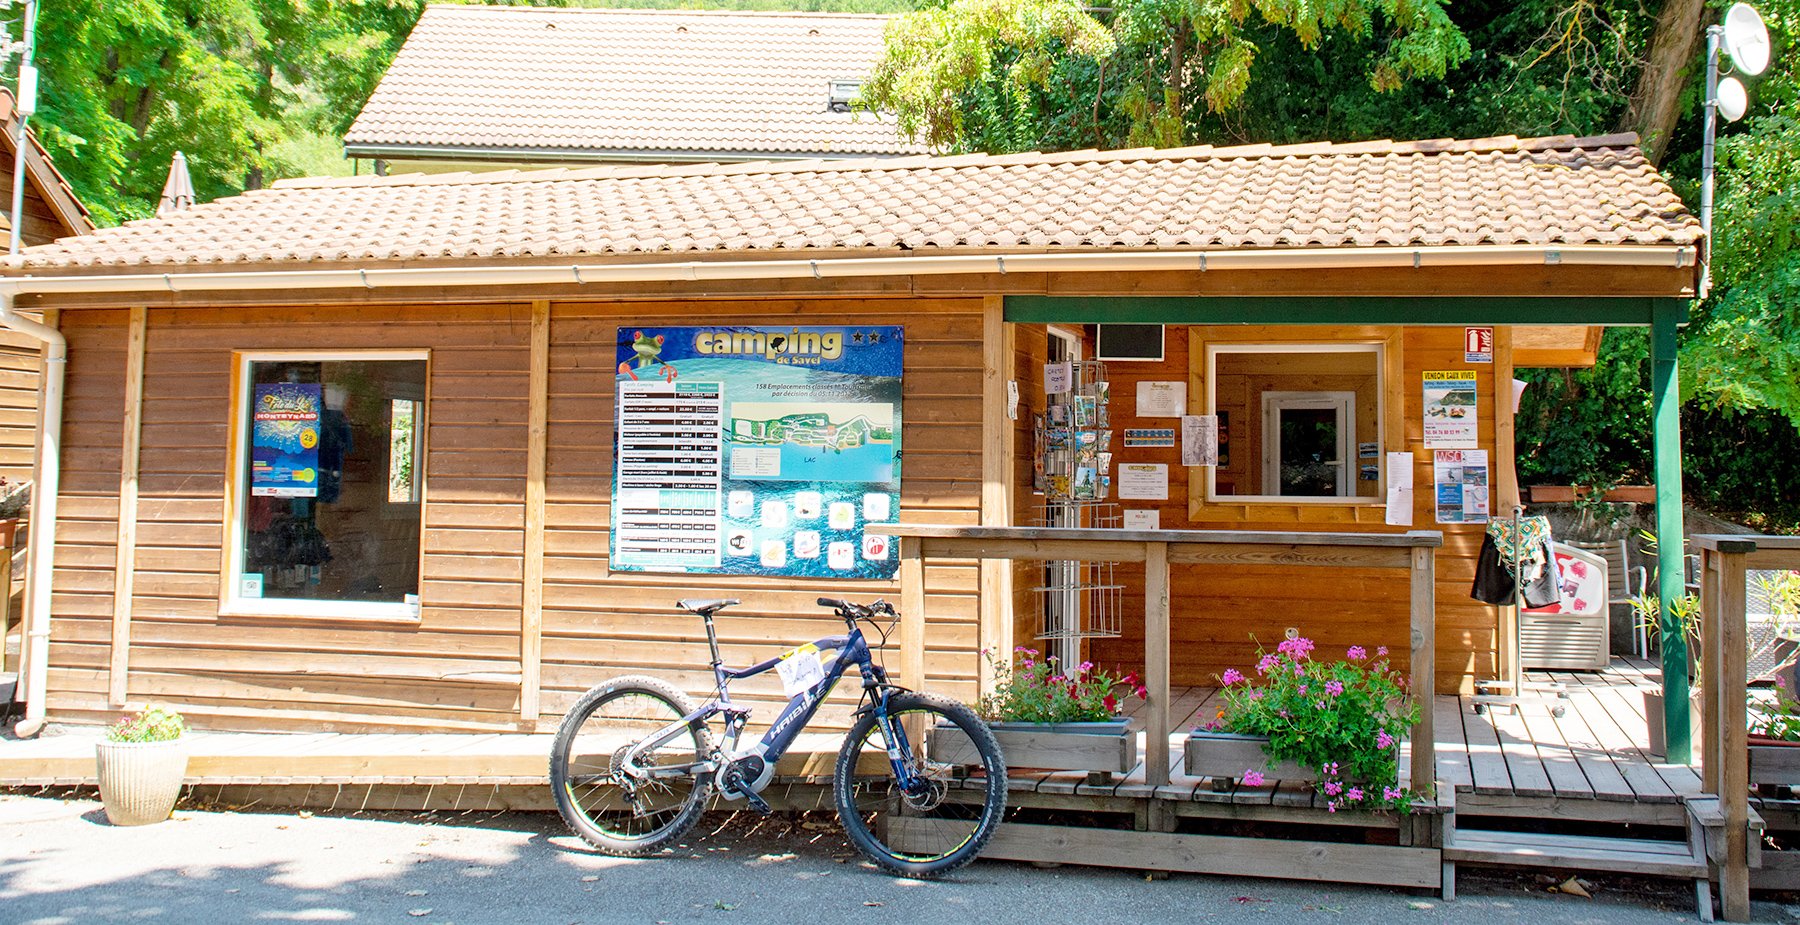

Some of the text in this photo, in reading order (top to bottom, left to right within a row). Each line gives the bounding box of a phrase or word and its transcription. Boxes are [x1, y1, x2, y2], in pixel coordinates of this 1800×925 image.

[695, 327, 843, 360] camping
[776, 356, 821, 365] de Savel
[1461, 371, 1475, 379] VIVES
[1436, 451, 1462, 463] WSC
[840, 740, 855, 808] SCHWALBE
